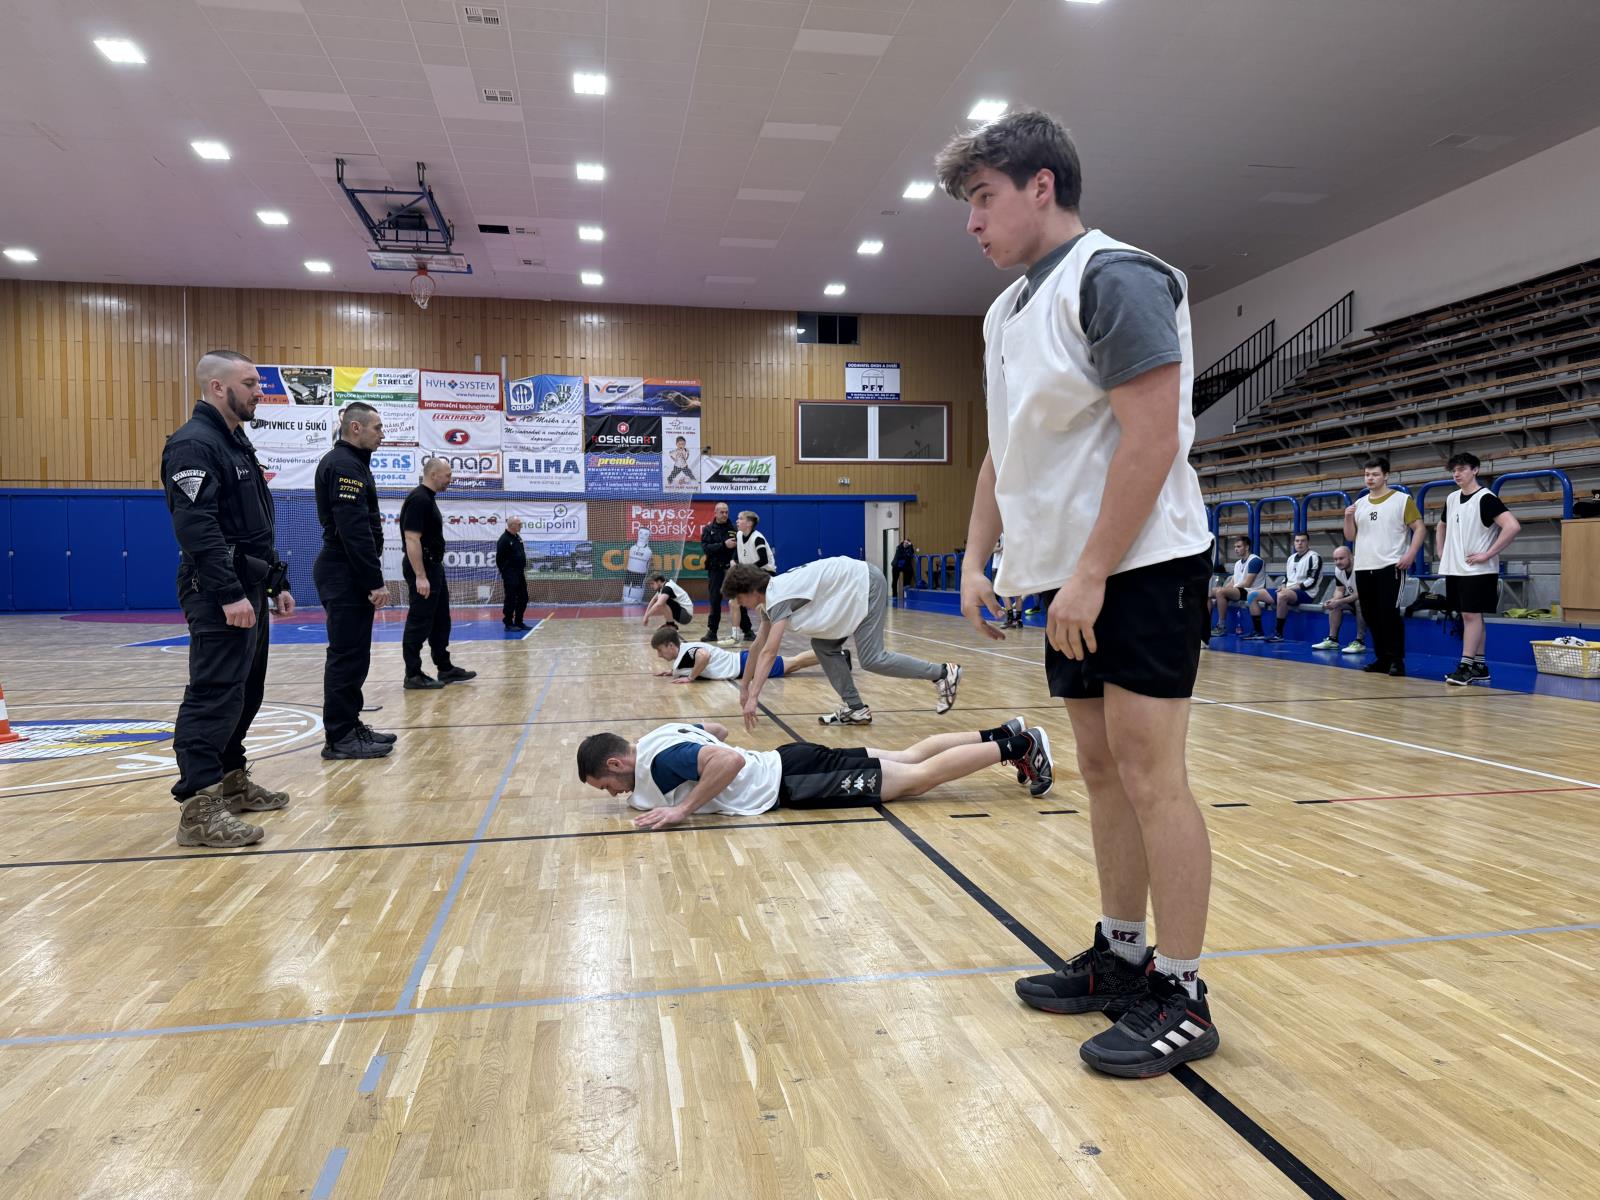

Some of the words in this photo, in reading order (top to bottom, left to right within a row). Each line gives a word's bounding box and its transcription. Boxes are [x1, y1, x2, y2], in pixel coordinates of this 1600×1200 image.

[425, 379, 446, 388] HVH
[459, 381, 496, 390] SYSTEM
[263, 421, 296, 430] PIVNICE
[297, 421, 303, 430] U
[305, 419, 327, 431] ŠUKŮ
[591, 435, 657, 444] ROSENGART
[508, 458, 580, 473] ELIMA
[598, 456, 636, 467] premio
[721, 459, 746, 474] Kar
[746, 459, 771, 475] Max
[338, 477, 364, 488] POLICIE
[631, 505, 695, 522] Parys.cz
[1369, 511, 1378, 521] 18
[631, 521, 695, 537] Rbářský
[443, 551, 497, 567] oma
